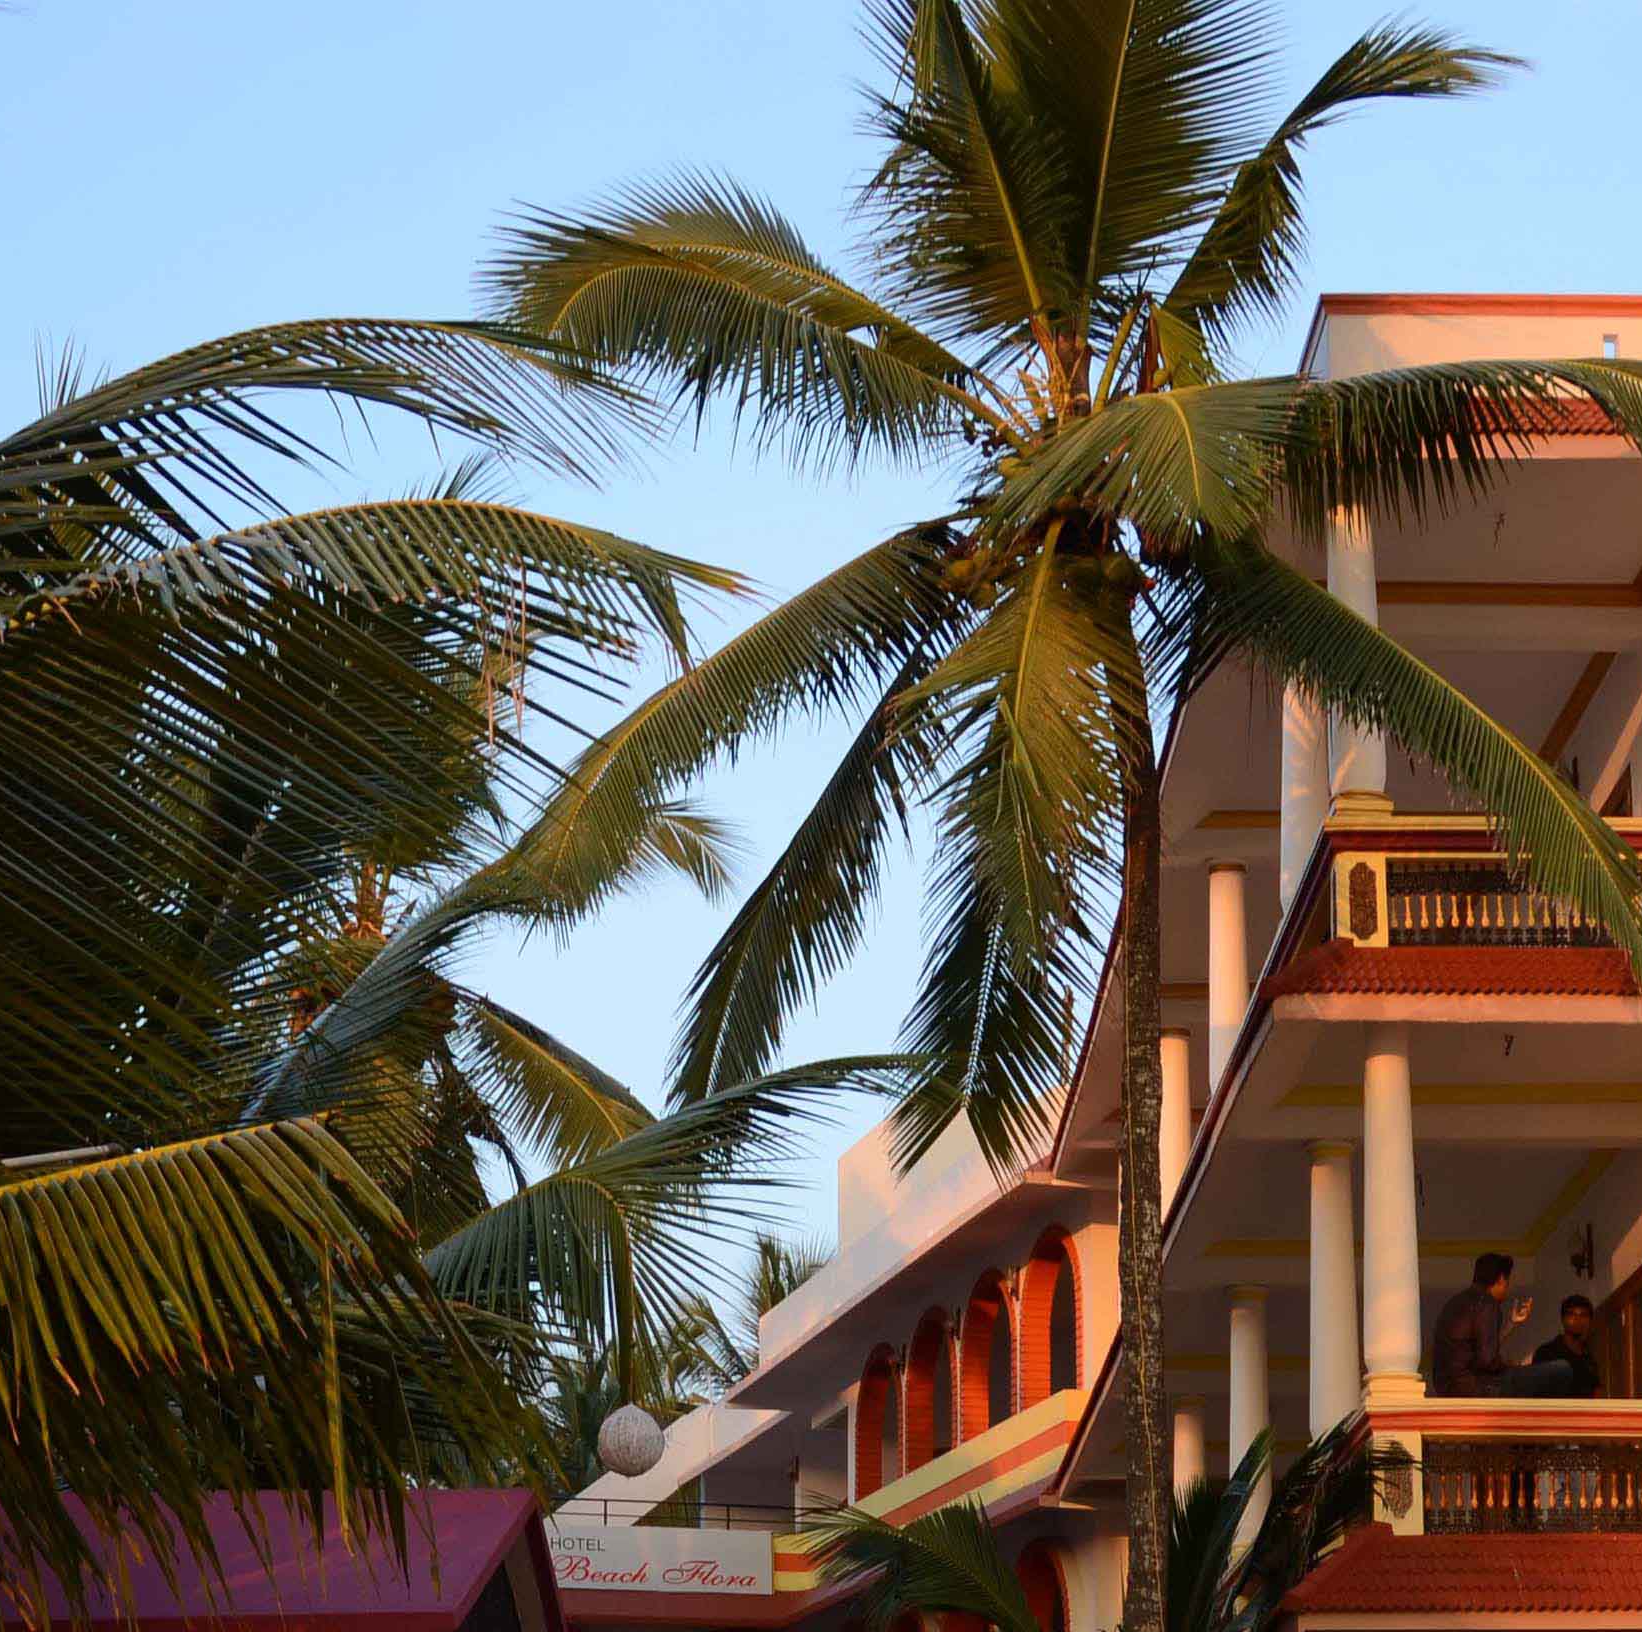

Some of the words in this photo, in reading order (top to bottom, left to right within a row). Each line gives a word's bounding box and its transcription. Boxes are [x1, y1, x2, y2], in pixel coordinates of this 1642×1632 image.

[550, 1537, 605, 1551] HOTEL
[553, 1555, 651, 1584] Beach
[663, 1560, 756, 1586] Flora
